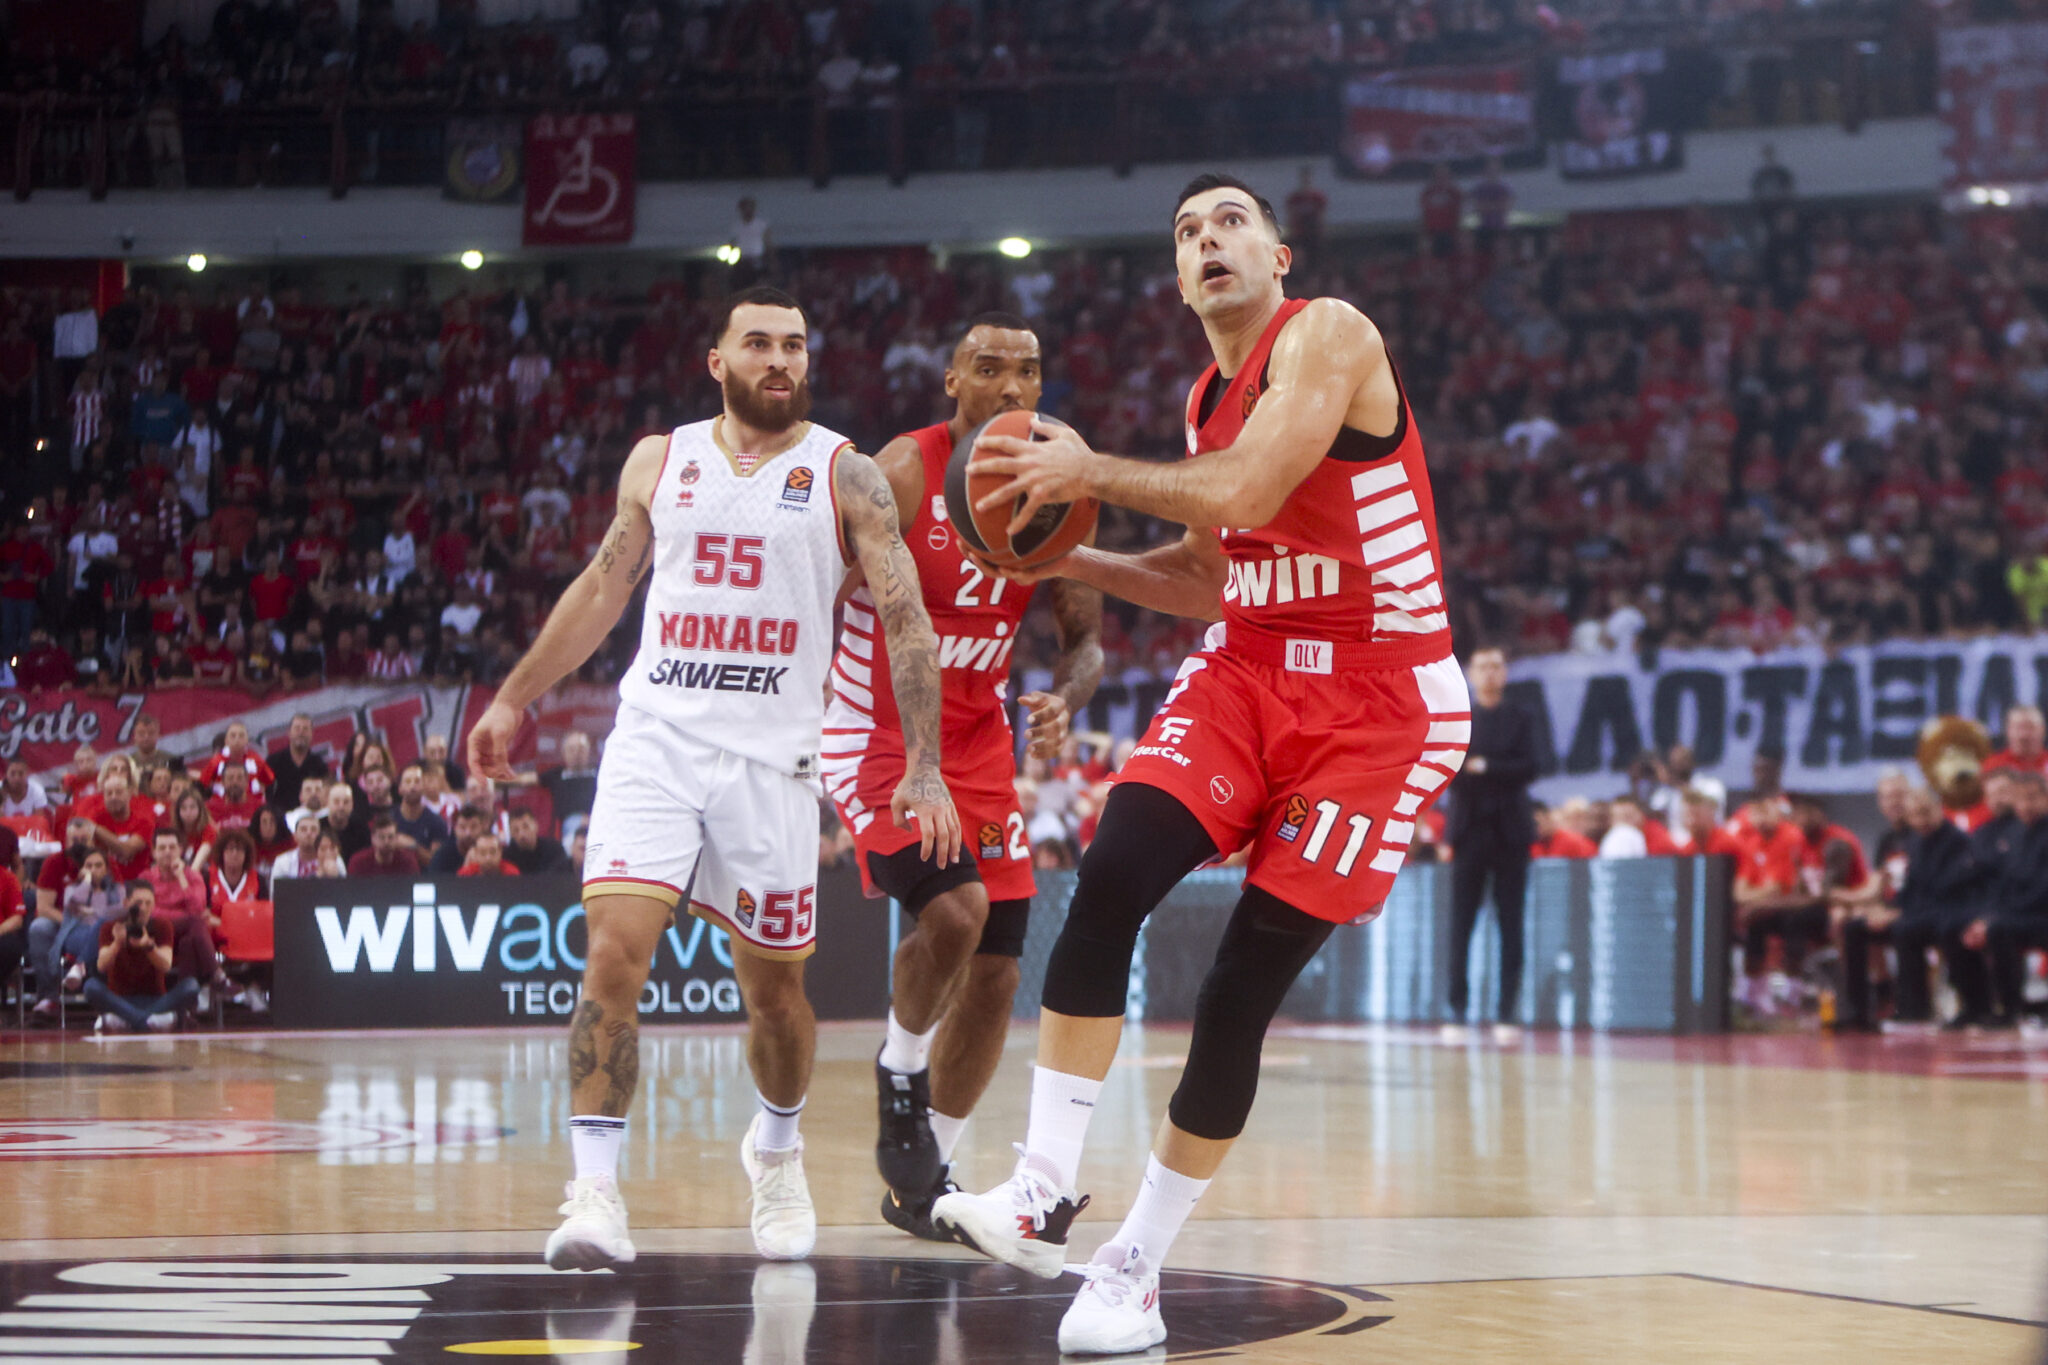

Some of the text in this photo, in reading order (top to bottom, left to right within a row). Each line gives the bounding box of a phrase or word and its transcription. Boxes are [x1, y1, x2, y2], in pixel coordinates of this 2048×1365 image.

[692, 532, 766, 591] 55
[658, 611, 800, 656] MONACO
[934, 621, 1015, 674] wi
[1294, 643, 1321, 669] OLY
[649, 658, 789, 695] SKWEEK
[0, 693, 145, 759] Gate 7
[1301, 797, 1374, 878] 11
[759, 883, 815, 943] 55
[501, 980, 741, 1015] TECOLOG
